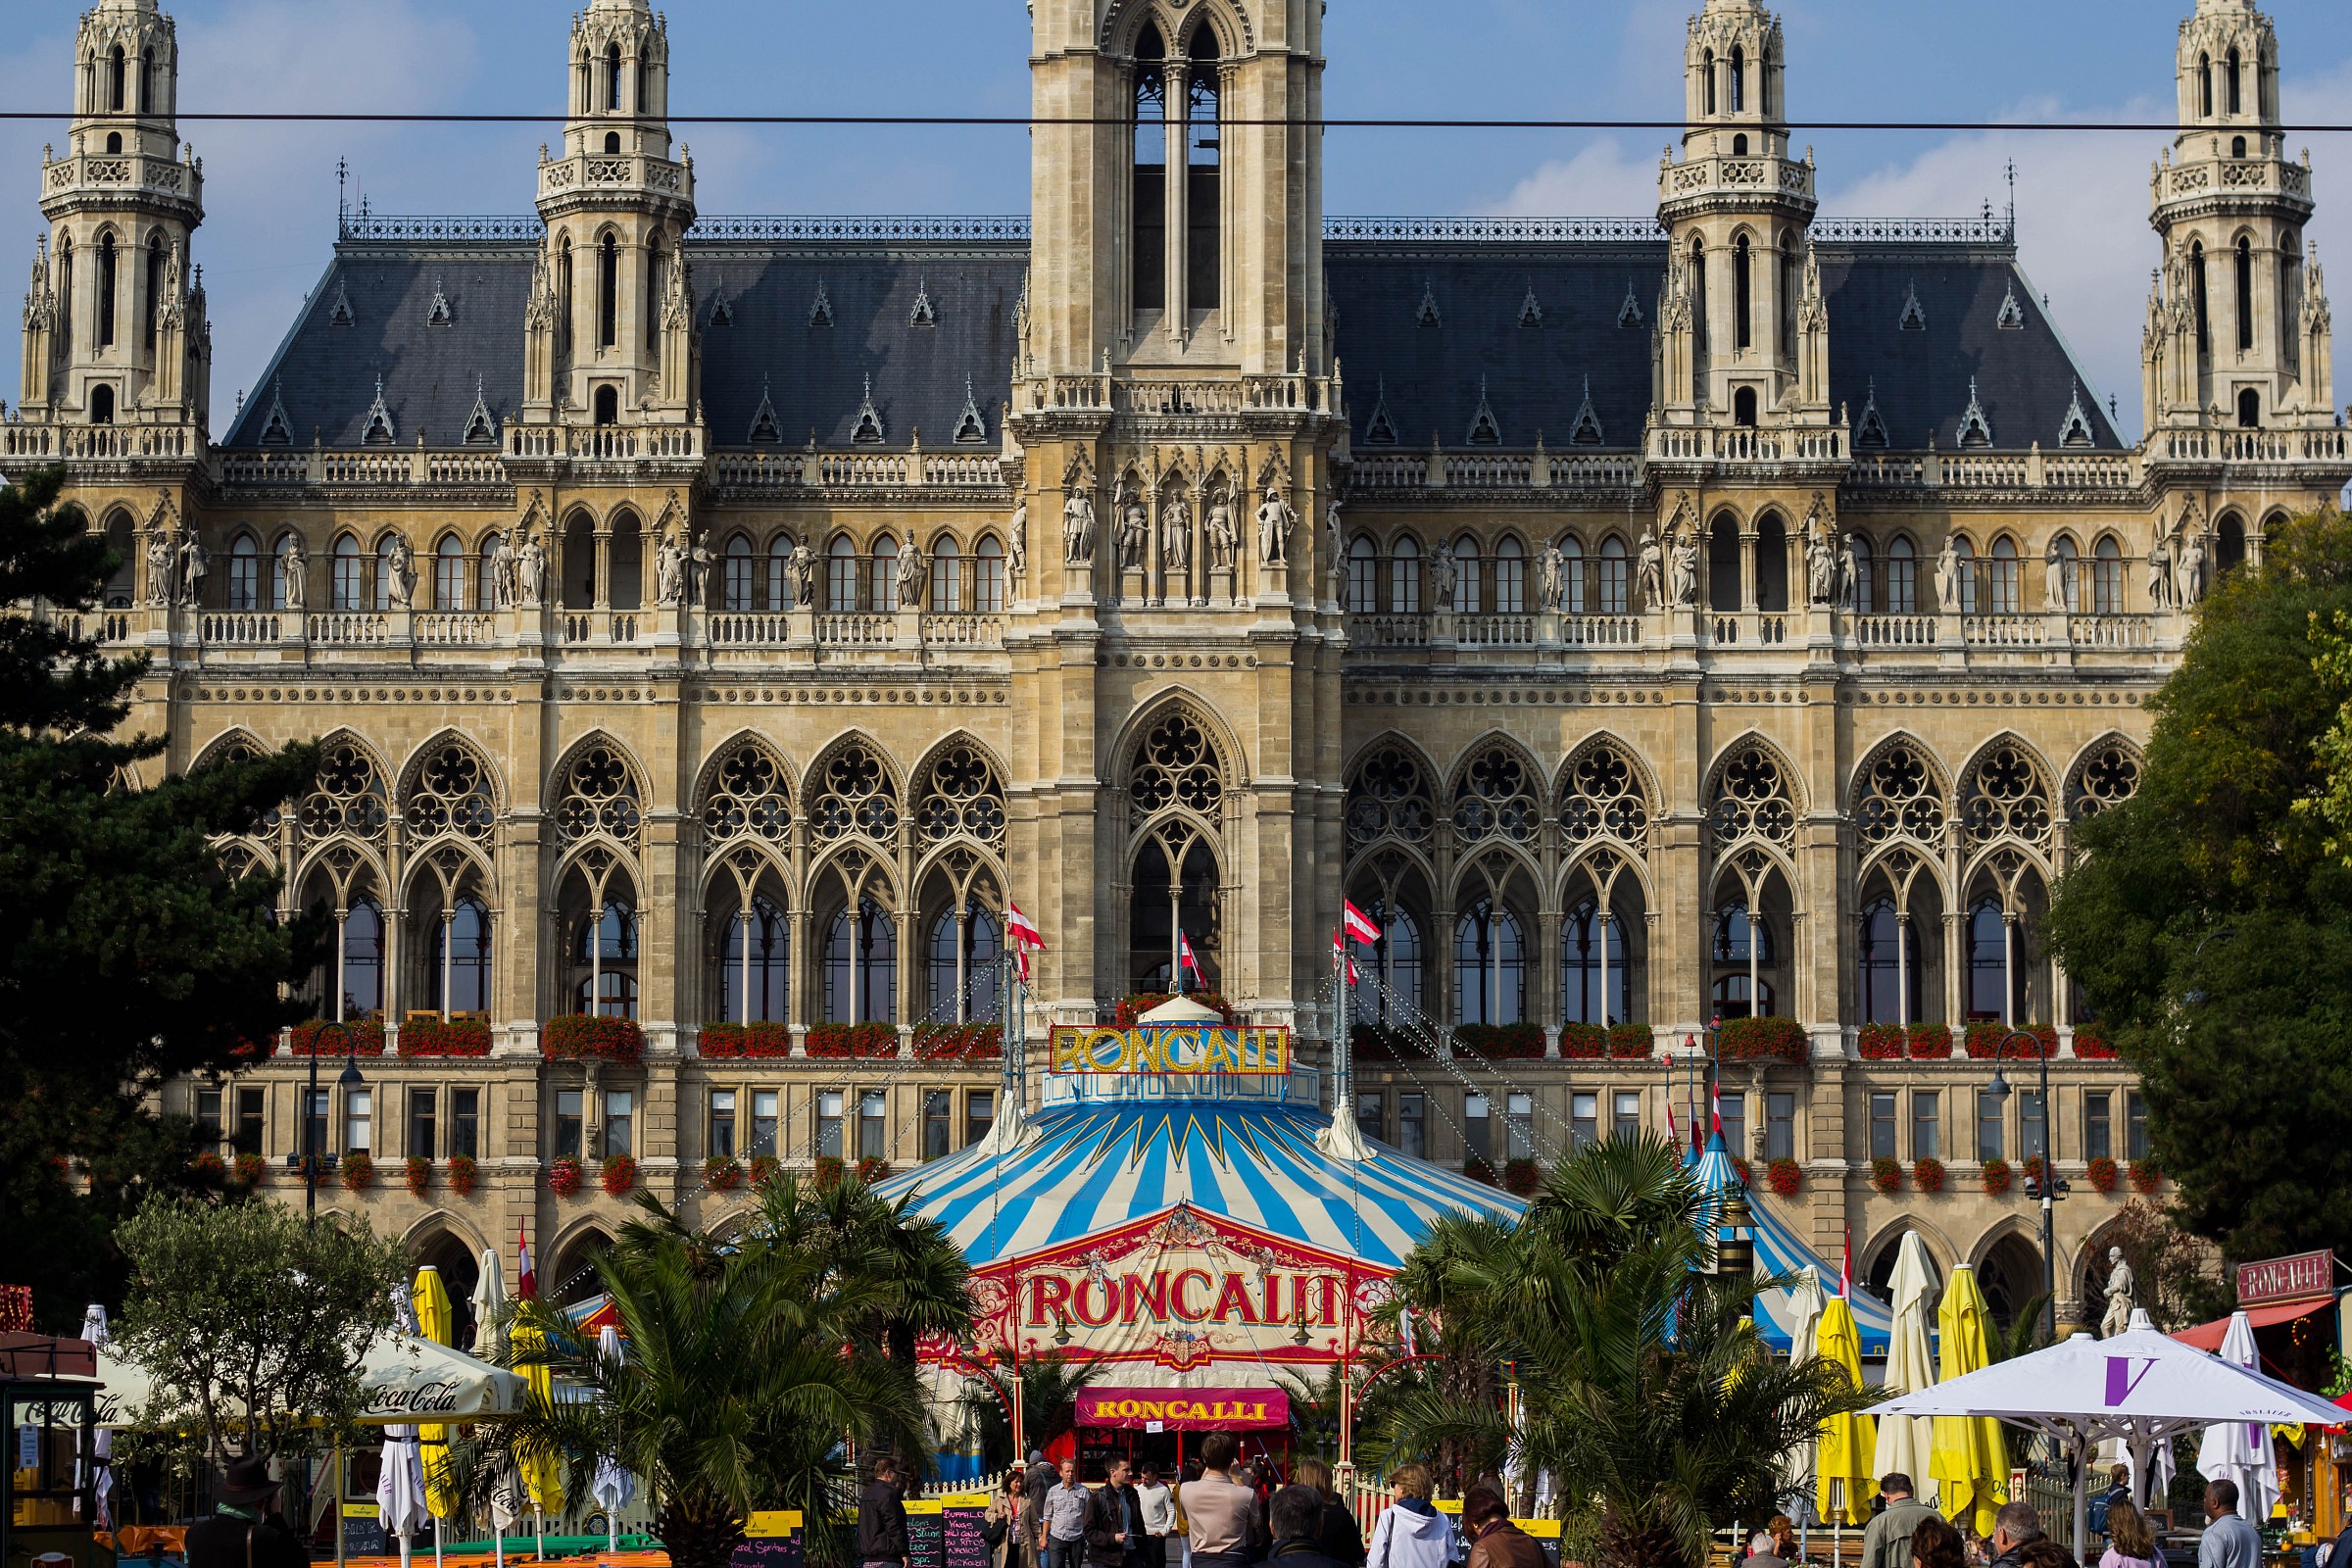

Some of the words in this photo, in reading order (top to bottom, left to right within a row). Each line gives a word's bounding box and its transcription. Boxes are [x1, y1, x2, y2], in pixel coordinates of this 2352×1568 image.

[1053, 1027, 1287, 1074] RONCALLI
[1028, 1268, 1342, 1327] RONCALLI
[2247, 1258, 2319, 1298] RONCALLI
[365, 1380, 463, 1414] Coca-Cola
[2104, 1355, 2160, 1407] V
[1093, 1398, 1269, 1420] RONCALLI
